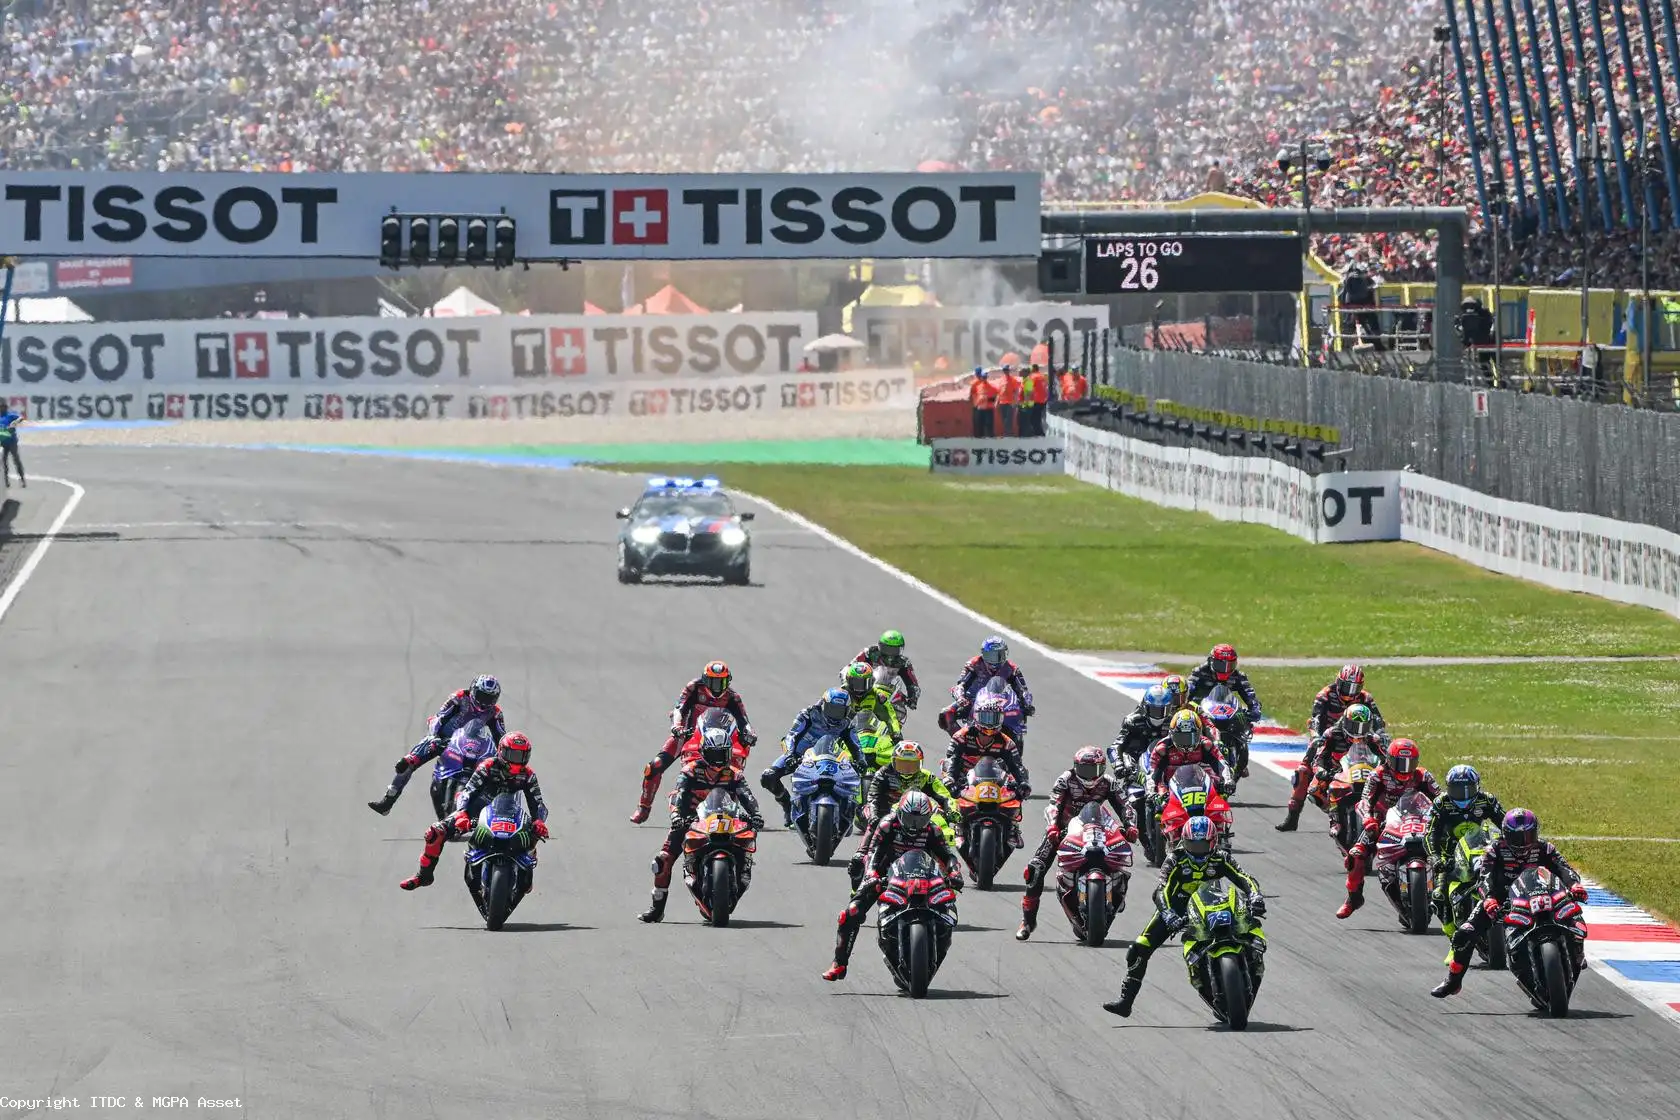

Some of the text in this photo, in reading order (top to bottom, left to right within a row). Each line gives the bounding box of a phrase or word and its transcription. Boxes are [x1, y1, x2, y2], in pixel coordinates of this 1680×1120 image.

[5, 185, 338, 244] TISSOT
[682, 185, 1016, 245] TISSOT
[1096, 241, 1183, 257] LAPS TO GO
[1120, 257, 1159, 290] 26
[0, 333, 165, 383] ISSOT
[276, 329, 481, 379] TISSOT
[593, 324, 801, 375] TISSOT
[189, 392, 288, 419] TISSOT
[511, 390, 615, 418] TISSOT
[670, 384, 767, 414] TISSOT
[820, 377, 907, 406] TISSOT
[30, 393, 133, 420] TISSOT
[346, 392, 454, 420] TISSOT
[971, 448, 1063, 465] TISSOT
[1322, 486, 1385, 527] OT
[978, 785, 999, 799] 23
[1181, 792, 1208, 808] 36
[490, 822, 517, 834] 20
[1400, 823, 1426, 834] 93
